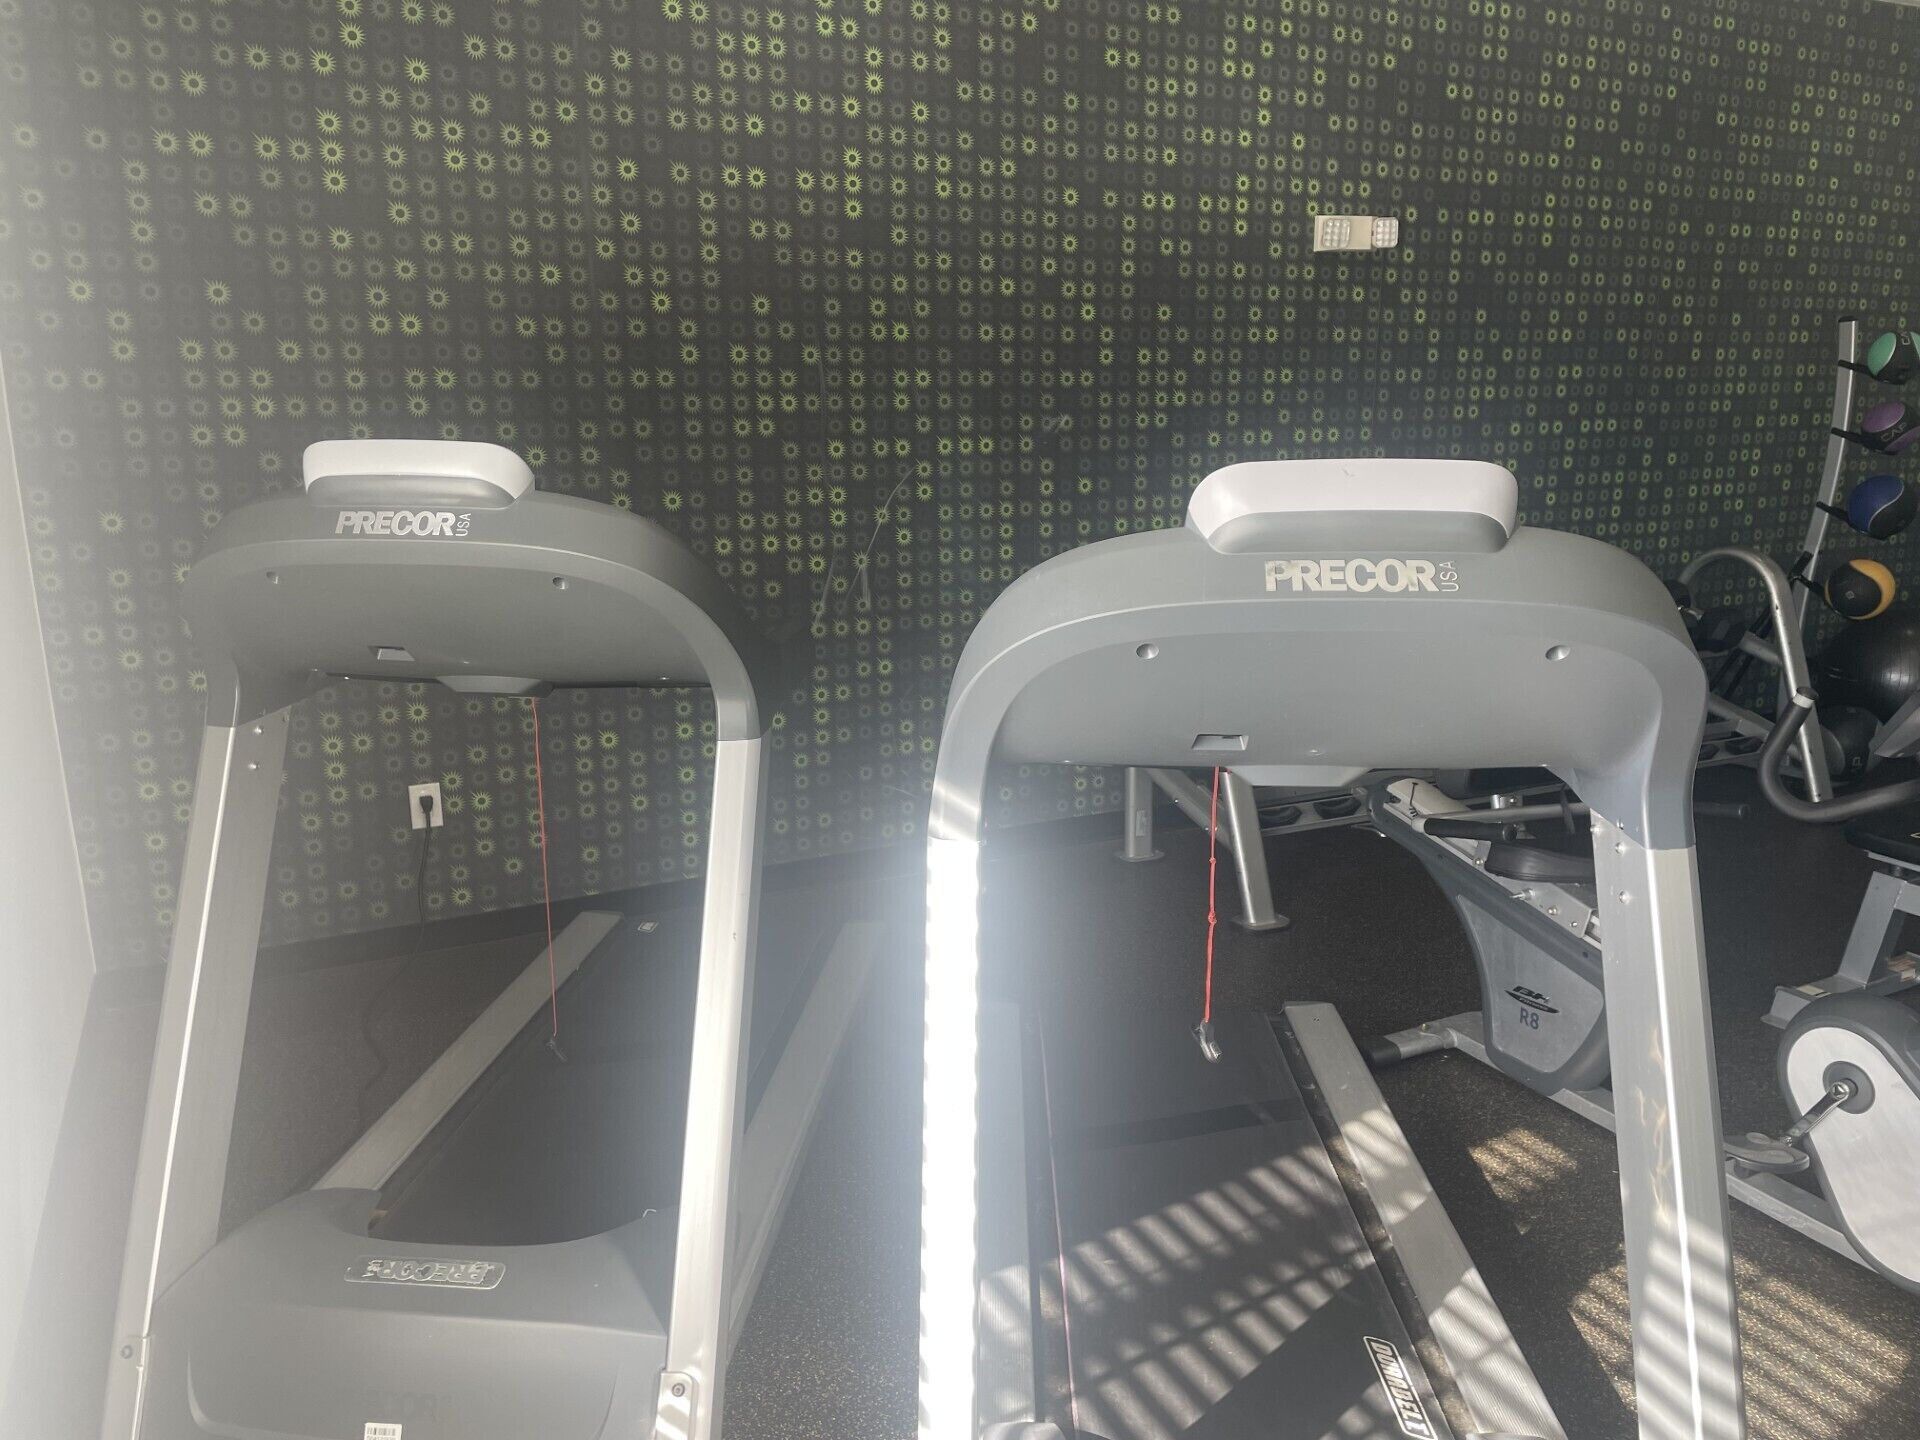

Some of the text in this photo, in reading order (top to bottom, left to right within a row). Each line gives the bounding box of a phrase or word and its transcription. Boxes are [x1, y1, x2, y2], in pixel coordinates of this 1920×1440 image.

[335, 511, 471, 537] PRECOR USA
[1265, 558, 1460, 592] PRECOR USA
[1519, 1007, 1540, 1030] R8
